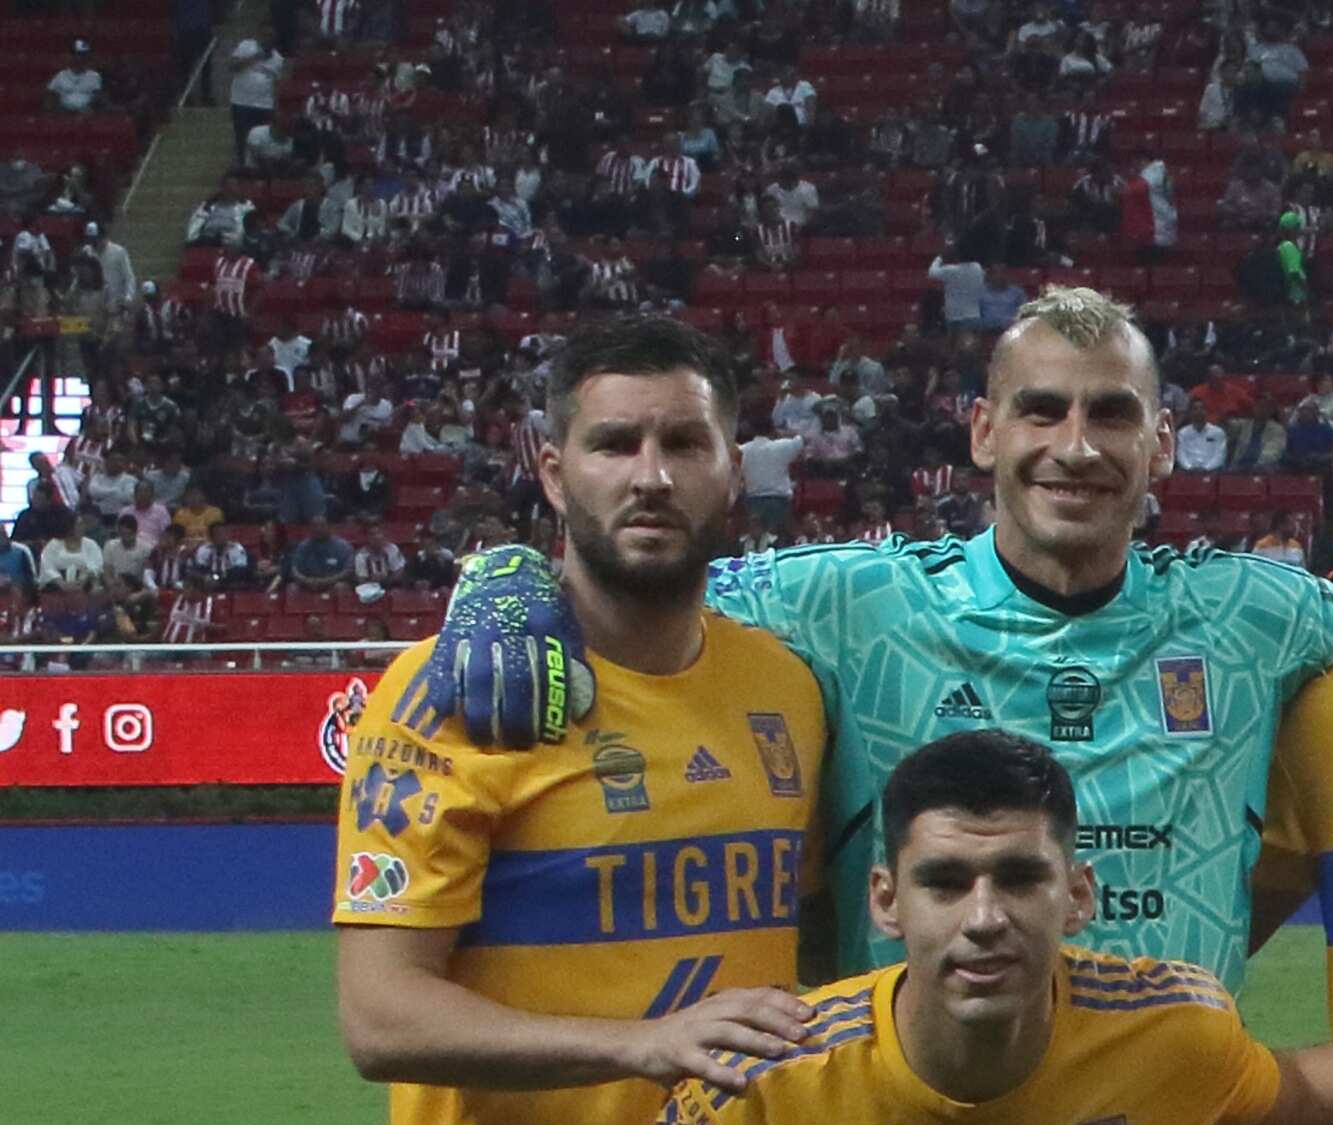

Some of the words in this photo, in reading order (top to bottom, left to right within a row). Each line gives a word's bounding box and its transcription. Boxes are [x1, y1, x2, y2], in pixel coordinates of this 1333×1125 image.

[545, 635, 568, 742] reusch
[934, 705, 993, 720] adidas
[1052, 725, 1091, 738] EXTRA
[1074, 824, 1174, 849] EMEX
[584, 836, 802, 934] TIGRE
[1091, 884, 1164, 921] tso
